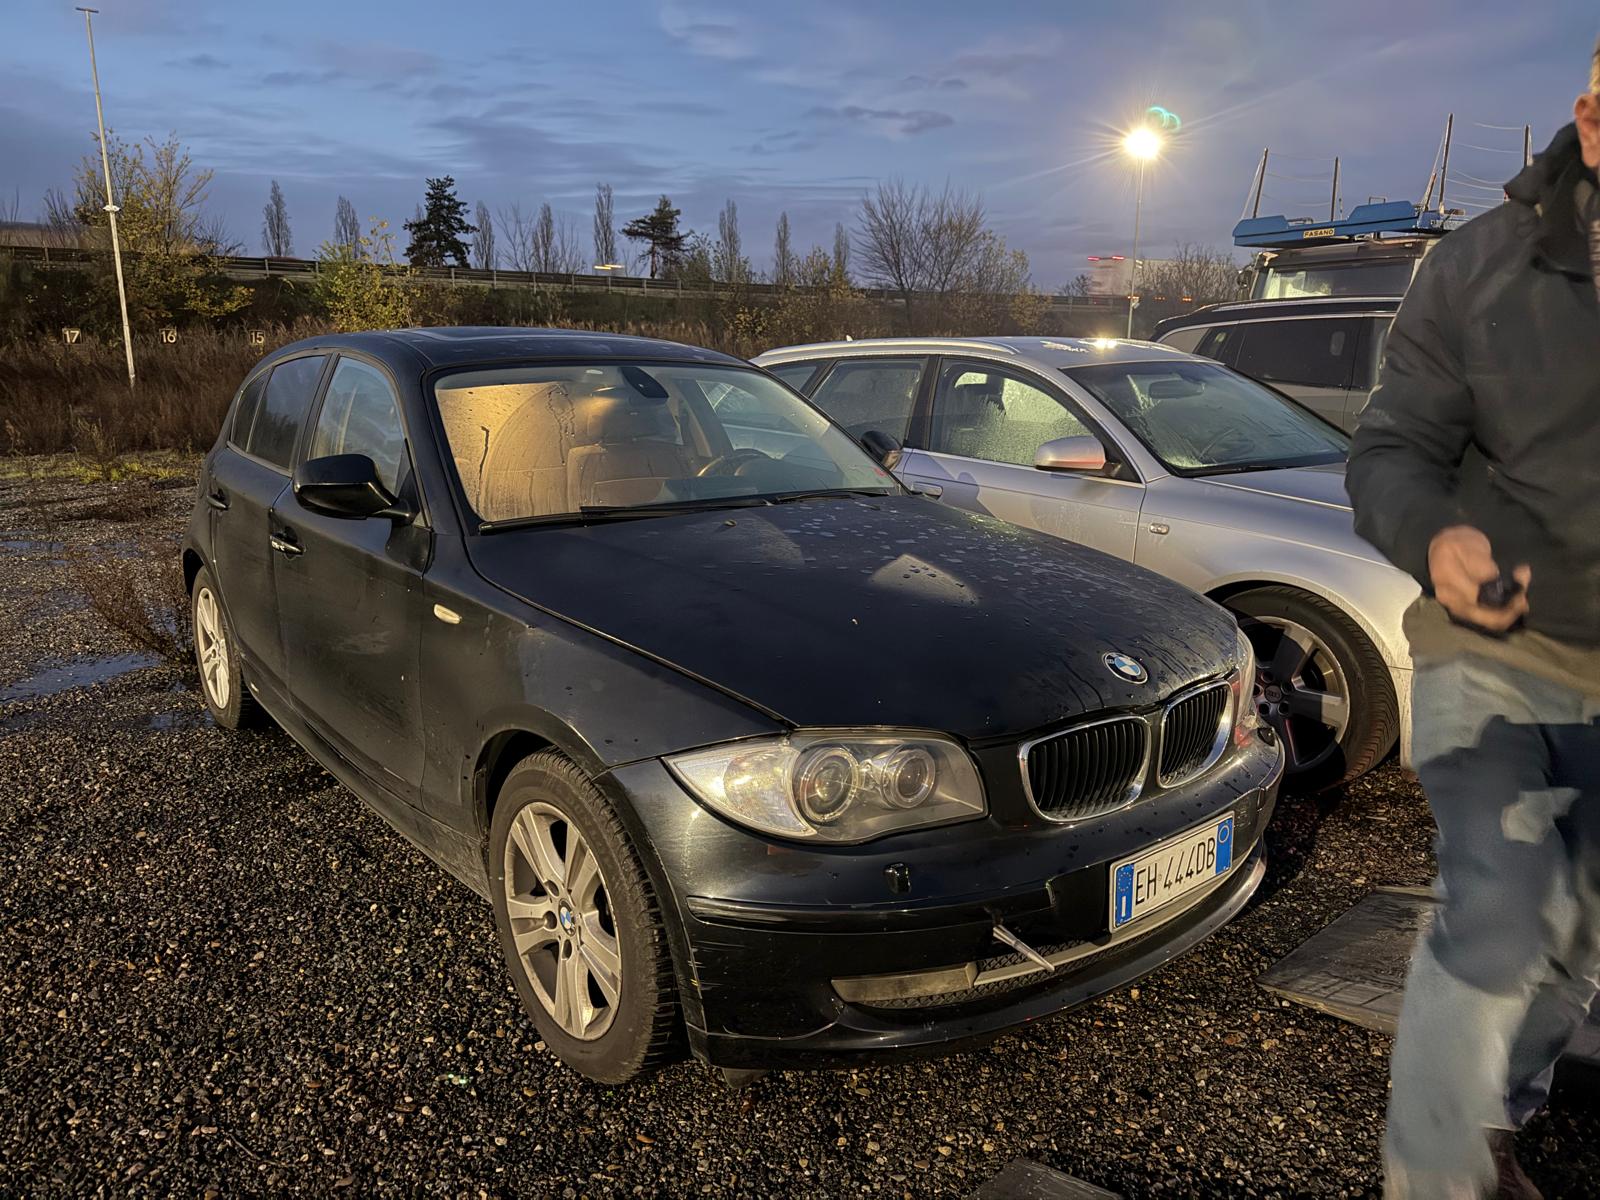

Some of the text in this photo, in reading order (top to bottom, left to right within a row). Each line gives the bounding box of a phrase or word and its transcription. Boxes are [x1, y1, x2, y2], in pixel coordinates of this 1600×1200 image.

[1304, 229, 1334, 237] FASANO
[64, 330, 80, 343] 17
[161, 330, 176, 343] 16
[250, 331, 264, 344] 15
[1121, 896, 1126, 918] I
